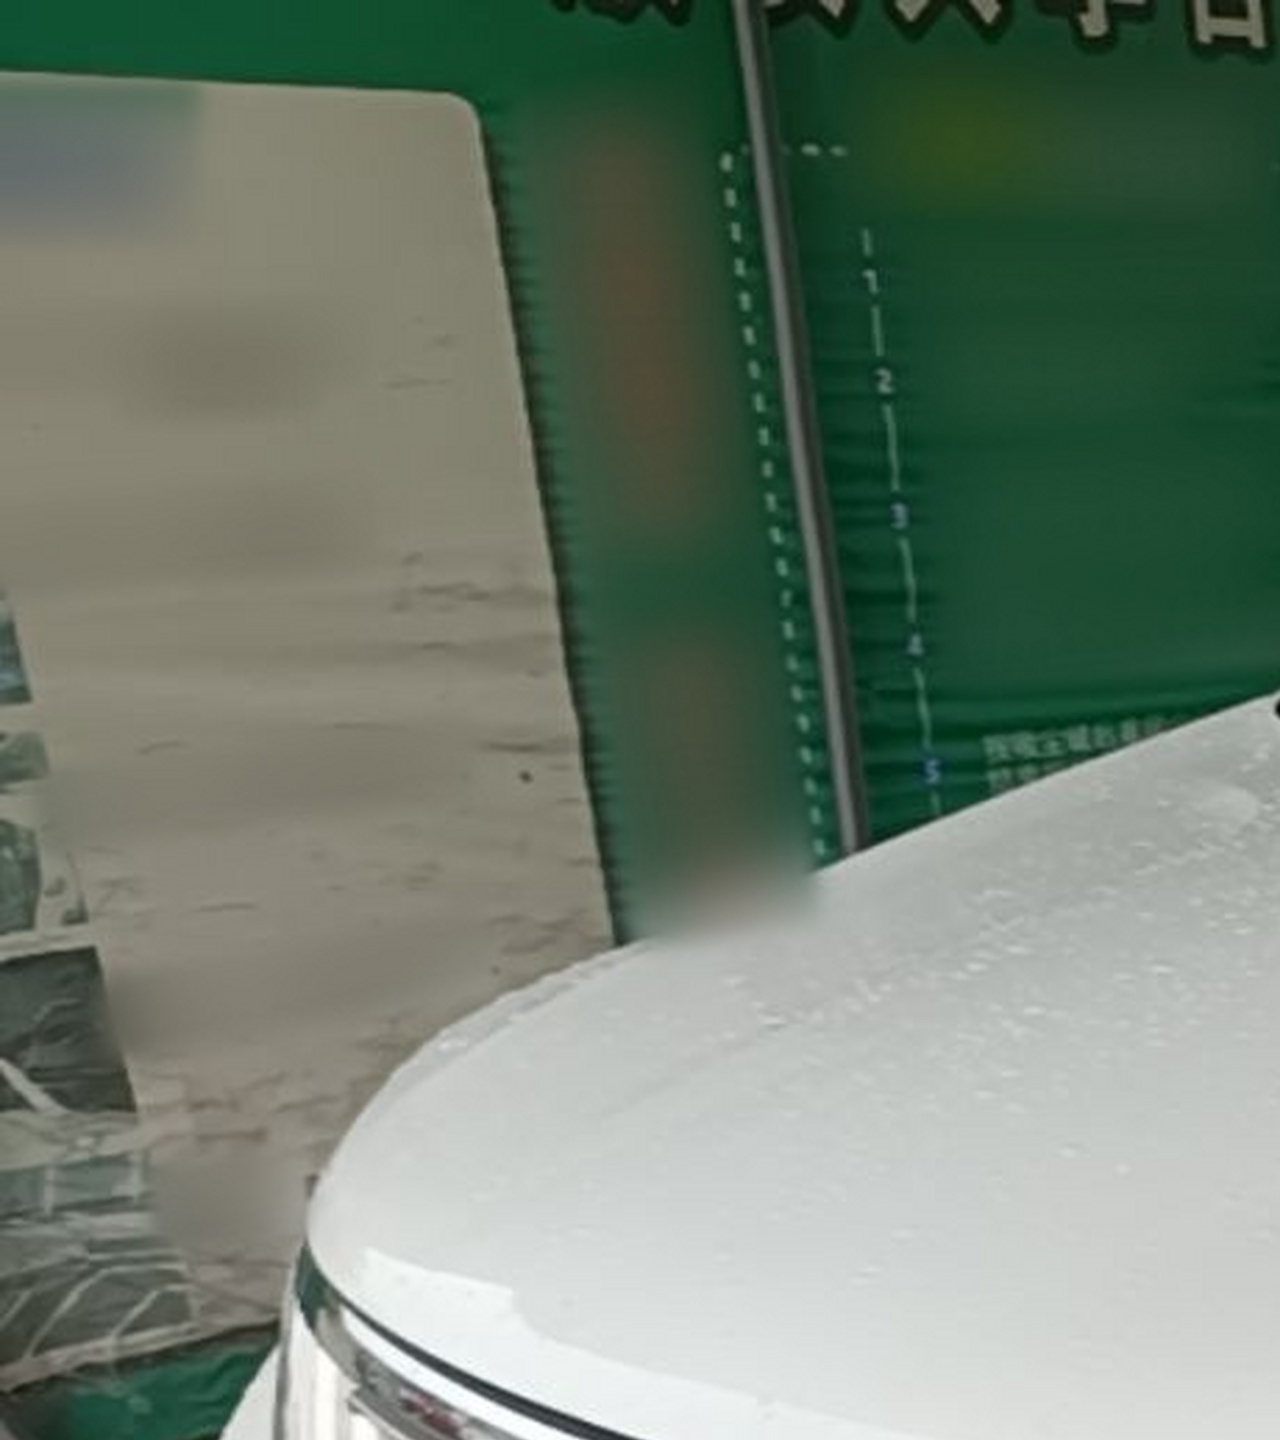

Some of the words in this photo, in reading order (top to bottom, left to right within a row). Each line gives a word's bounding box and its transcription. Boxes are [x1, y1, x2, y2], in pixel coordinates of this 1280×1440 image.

[873, 366, 896, 394] 2
[890, 503, 910, 530] 3
[922, 757, 942, 784] 5
